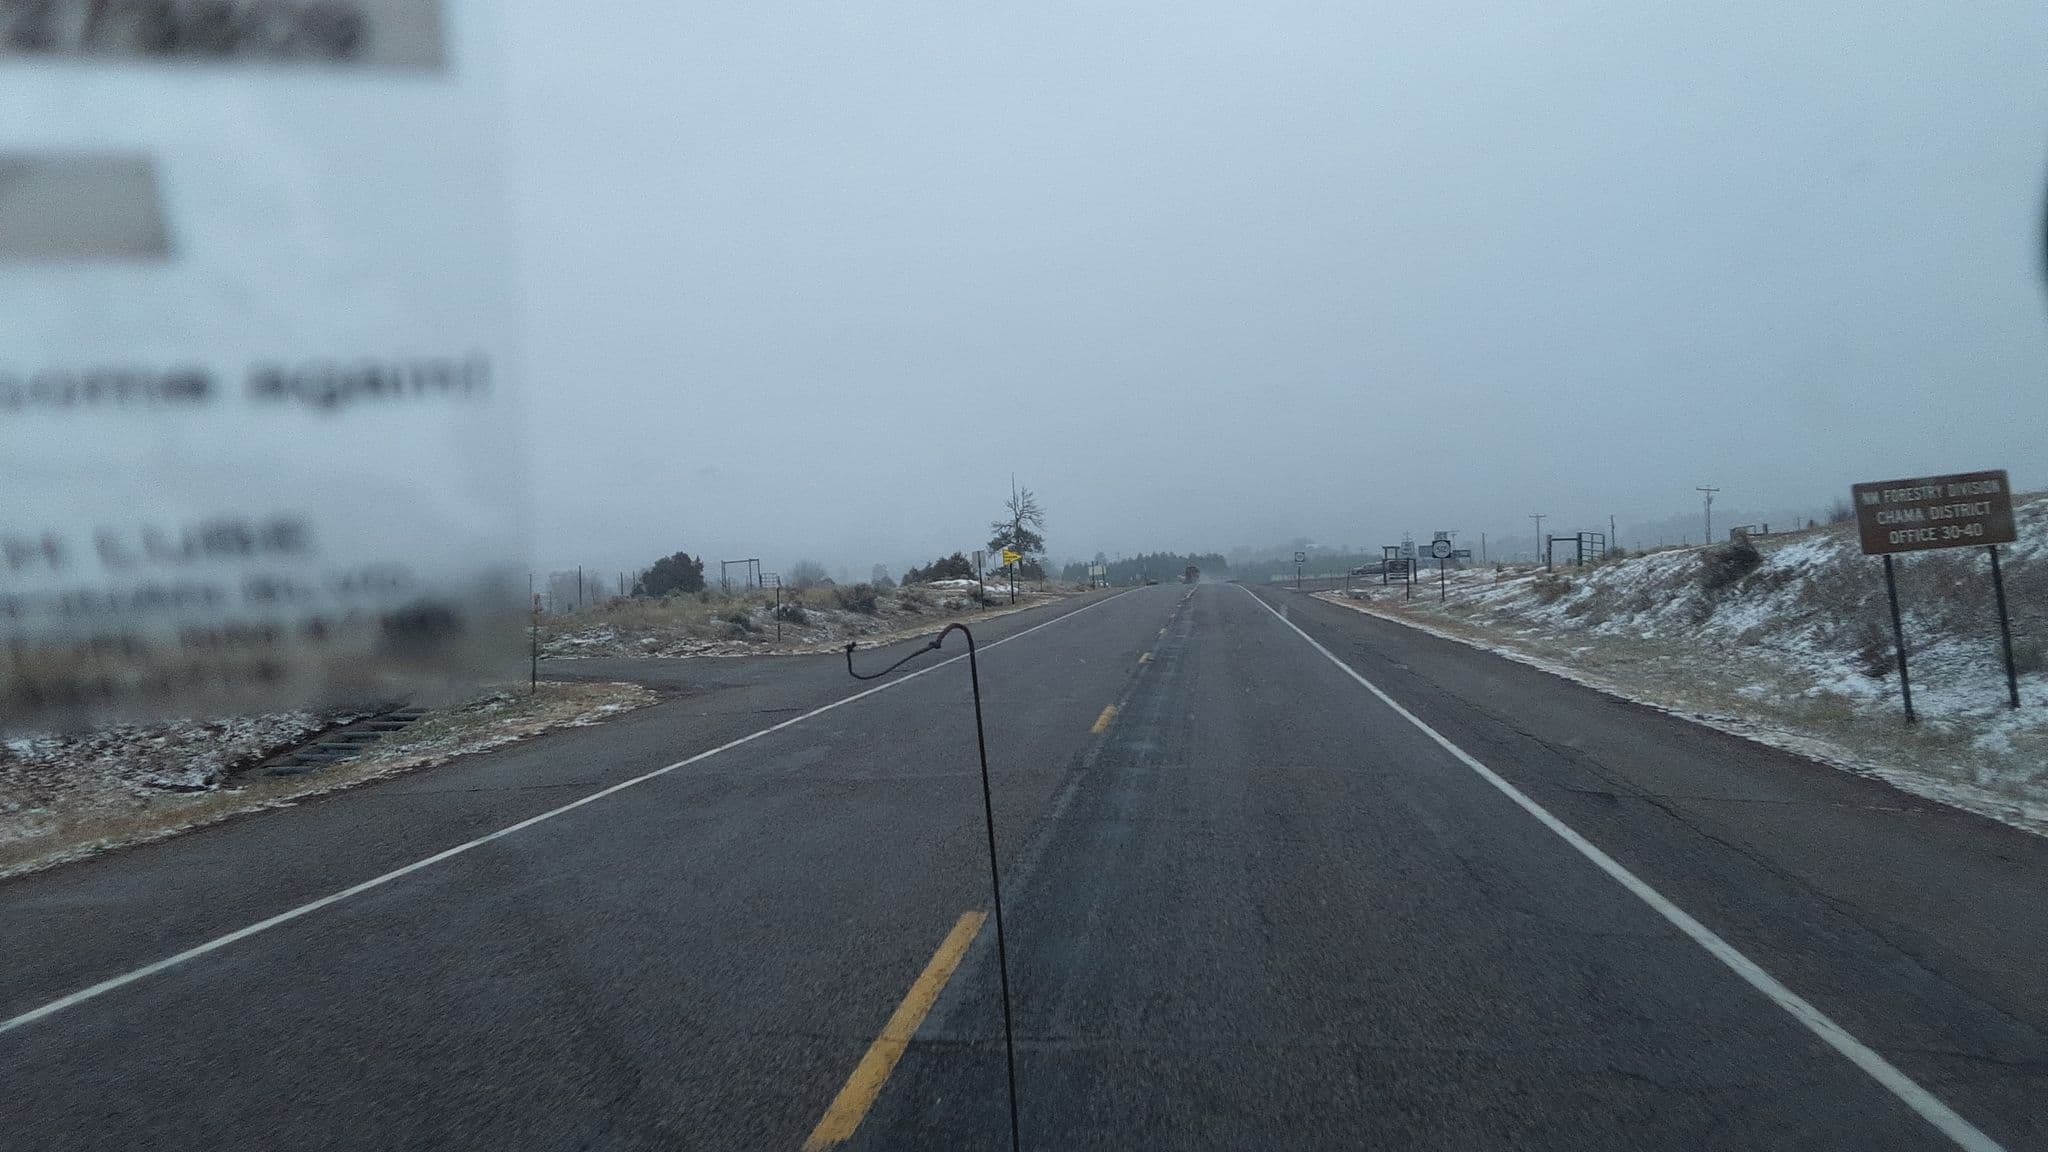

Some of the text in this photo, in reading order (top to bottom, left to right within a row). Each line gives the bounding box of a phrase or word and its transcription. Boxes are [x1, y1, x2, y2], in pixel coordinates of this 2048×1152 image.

[1884, 486, 1943, 503] FORESTRY
[1947, 479, 2000, 497] DIVISION
[1876, 501, 1991, 525] CHAMA DISTRICT
[1889, 523, 1984, 544] OFFICE 30-40
